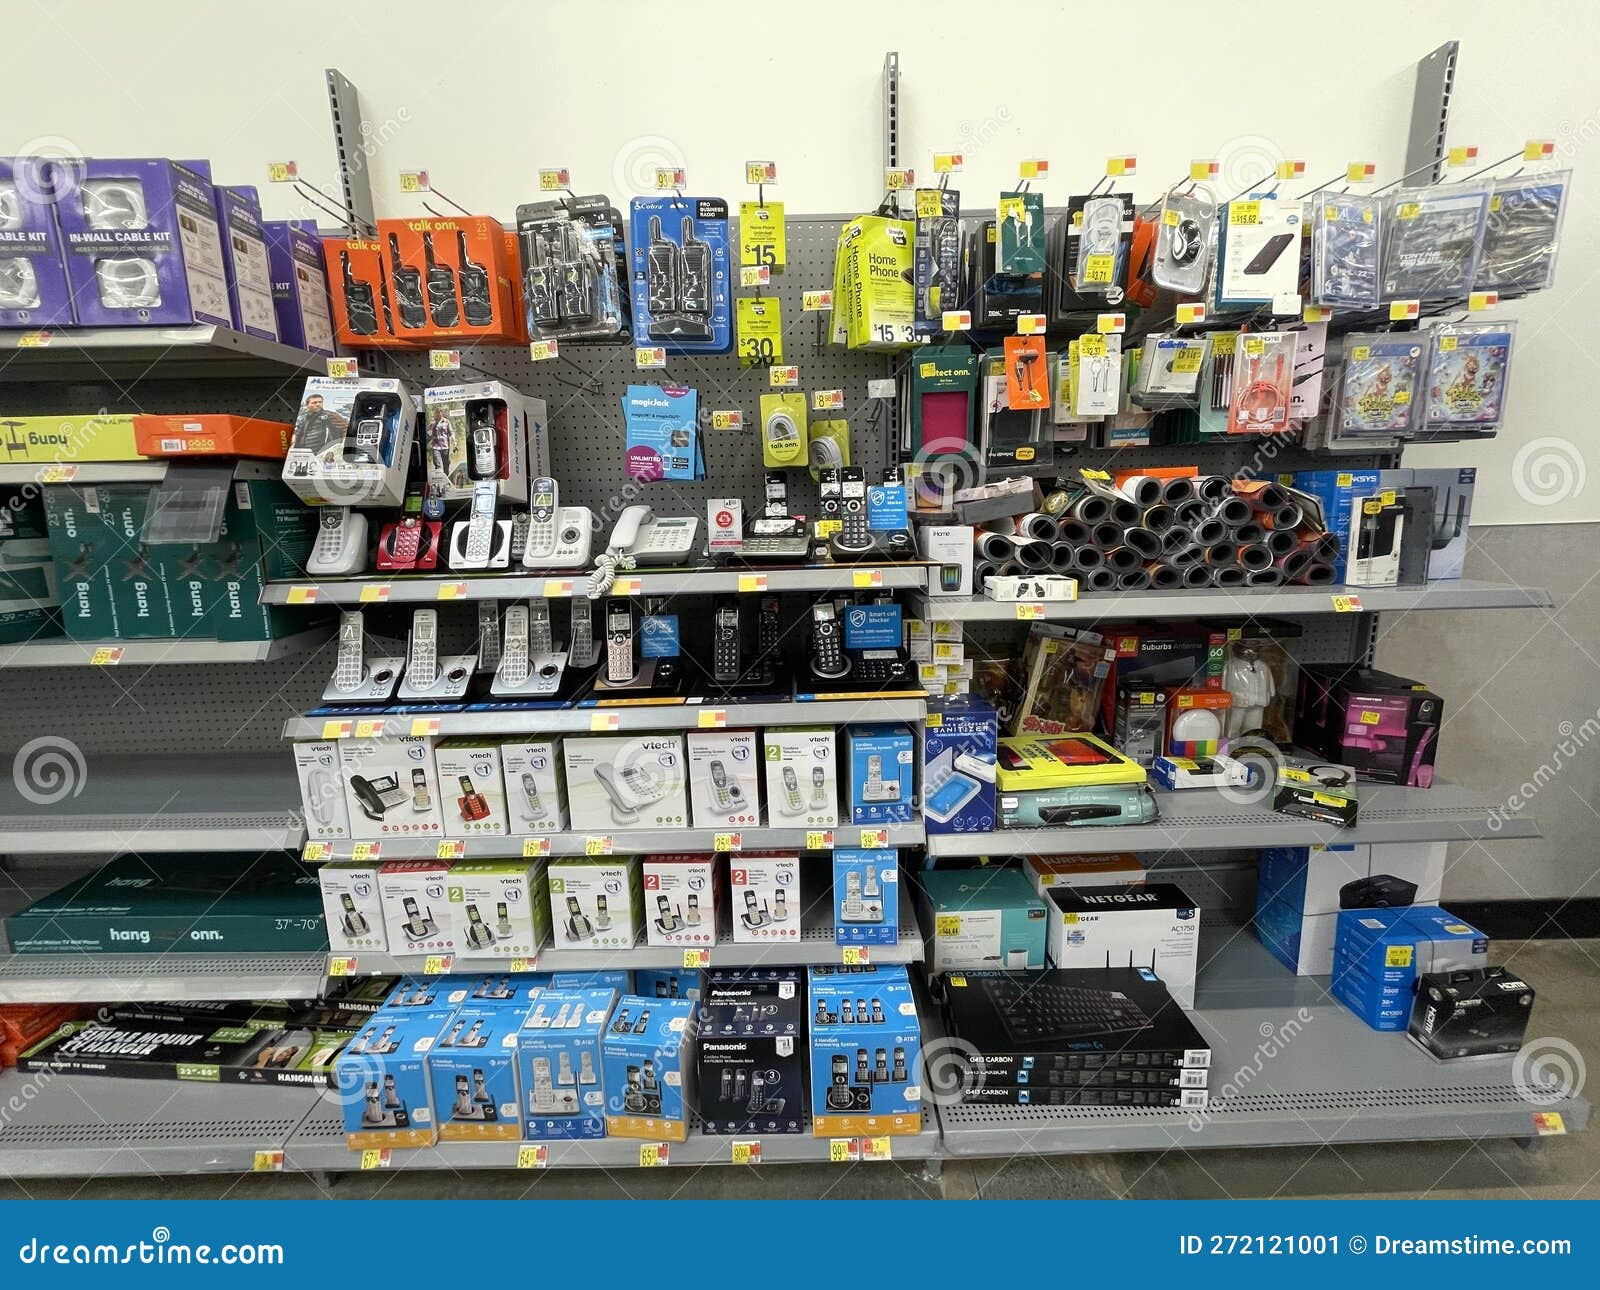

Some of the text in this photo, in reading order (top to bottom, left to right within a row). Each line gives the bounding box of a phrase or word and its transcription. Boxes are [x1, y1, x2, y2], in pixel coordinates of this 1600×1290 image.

[408, 221, 459, 232] talk onn.
[29, 231, 47, 241] KIT
[69, 231, 171, 243] IN-WALL CABLE KIT
[869, 254, 896, 266] Home
[870, 265, 899, 278] Phone
[276, 282, 290, 290] KIT
[1158, 340, 1188, 349] Gillette
[953, 369, 971, 377] onn.
[631, 398, 670, 407] magicJack
[64, 508, 77, 538] onn.
[123, 507, 135, 538] onn.
[77, 582, 91, 618] hang
[134, 582, 150, 618] hang
[189, 580, 203, 617] hang
[227, 581, 241, 618] hang
[1141, 643, 1171, 651] Suburbs
[933, 725, 989, 733] SANITIZER
[642, 740, 676, 750] vtech
[1082, 893, 1158, 904] NETGEAR
[109, 928, 224, 943] hang onn.
[141, 1032, 204, 1046] MOUNT
[703, 1043, 747, 1051] Panasonic
[277, 1073, 328, 1084] HANGMAN
